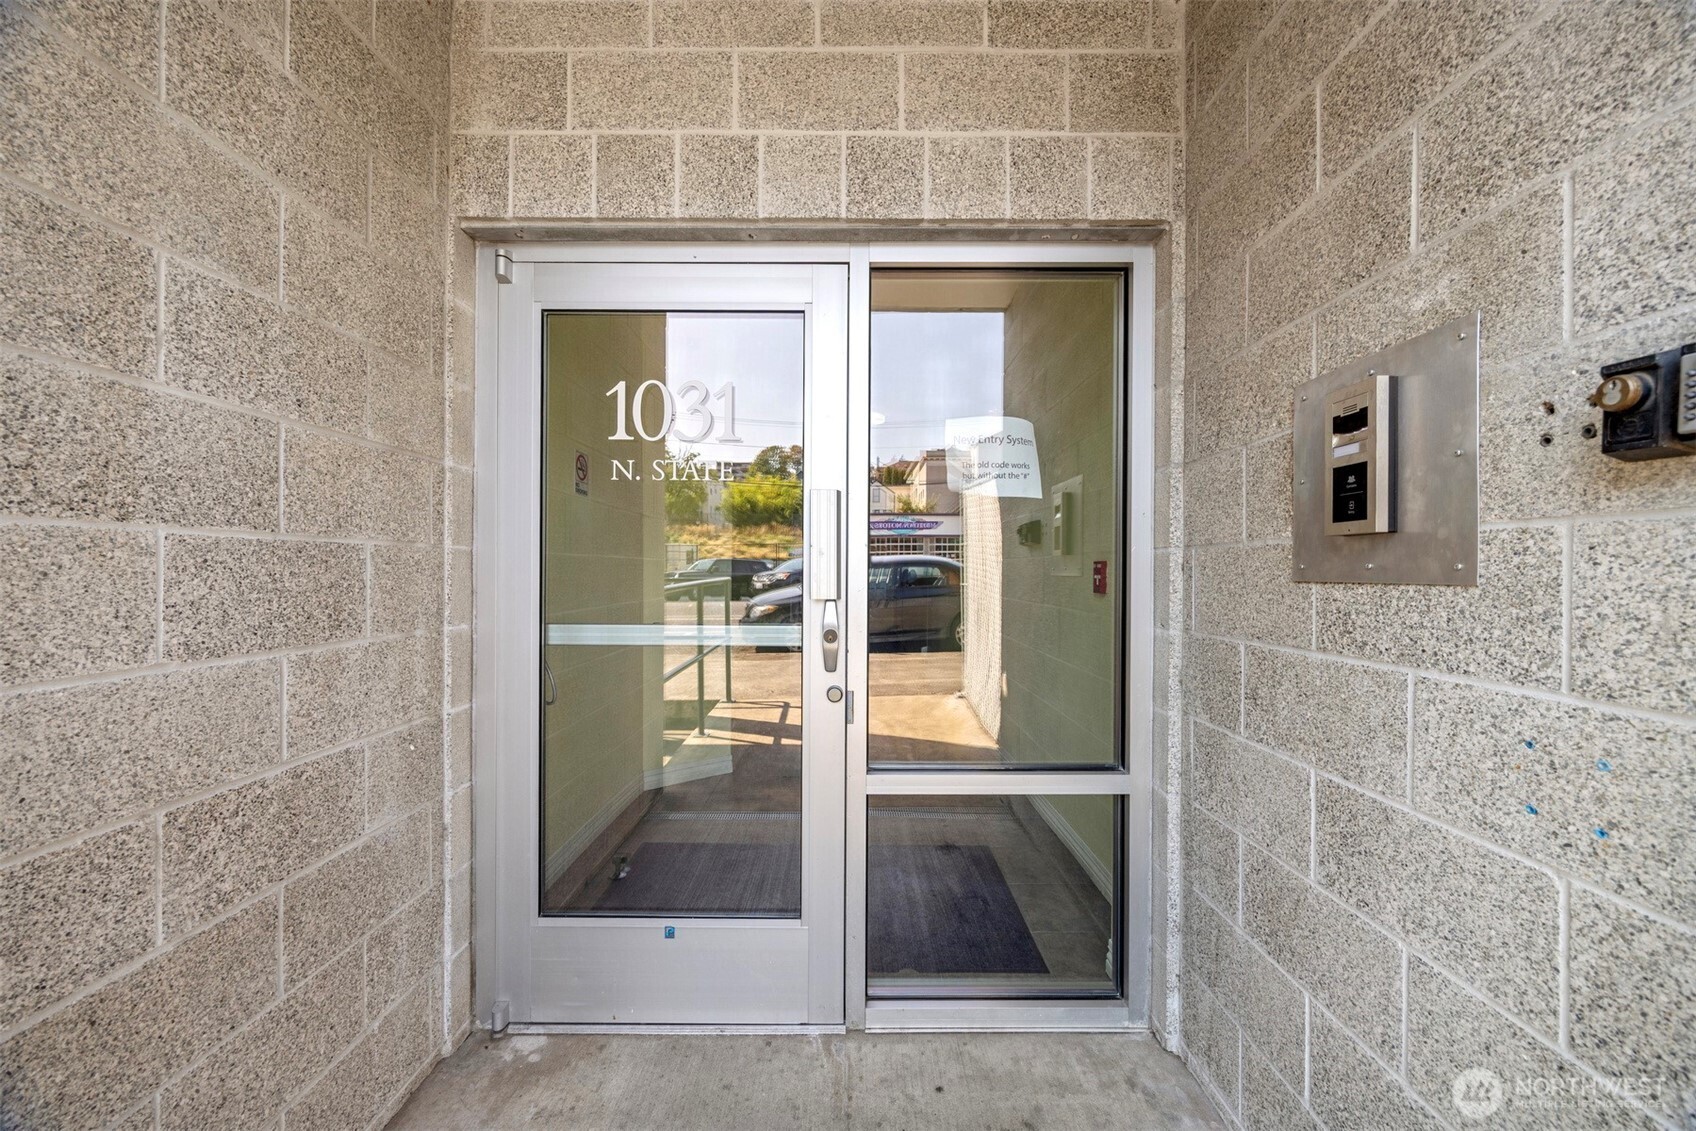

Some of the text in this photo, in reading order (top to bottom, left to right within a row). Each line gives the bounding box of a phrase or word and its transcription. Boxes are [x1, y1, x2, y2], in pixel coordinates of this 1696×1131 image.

[605, 379, 743, 443] 1031
[953, 434, 1034, 447] New Entry System
[611, 459, 734, 481] N. STATE
[962, 461, 1030, 470] The old code works
[962, 472, 975, 480] but
[1008, 471, 1020, 480] the
